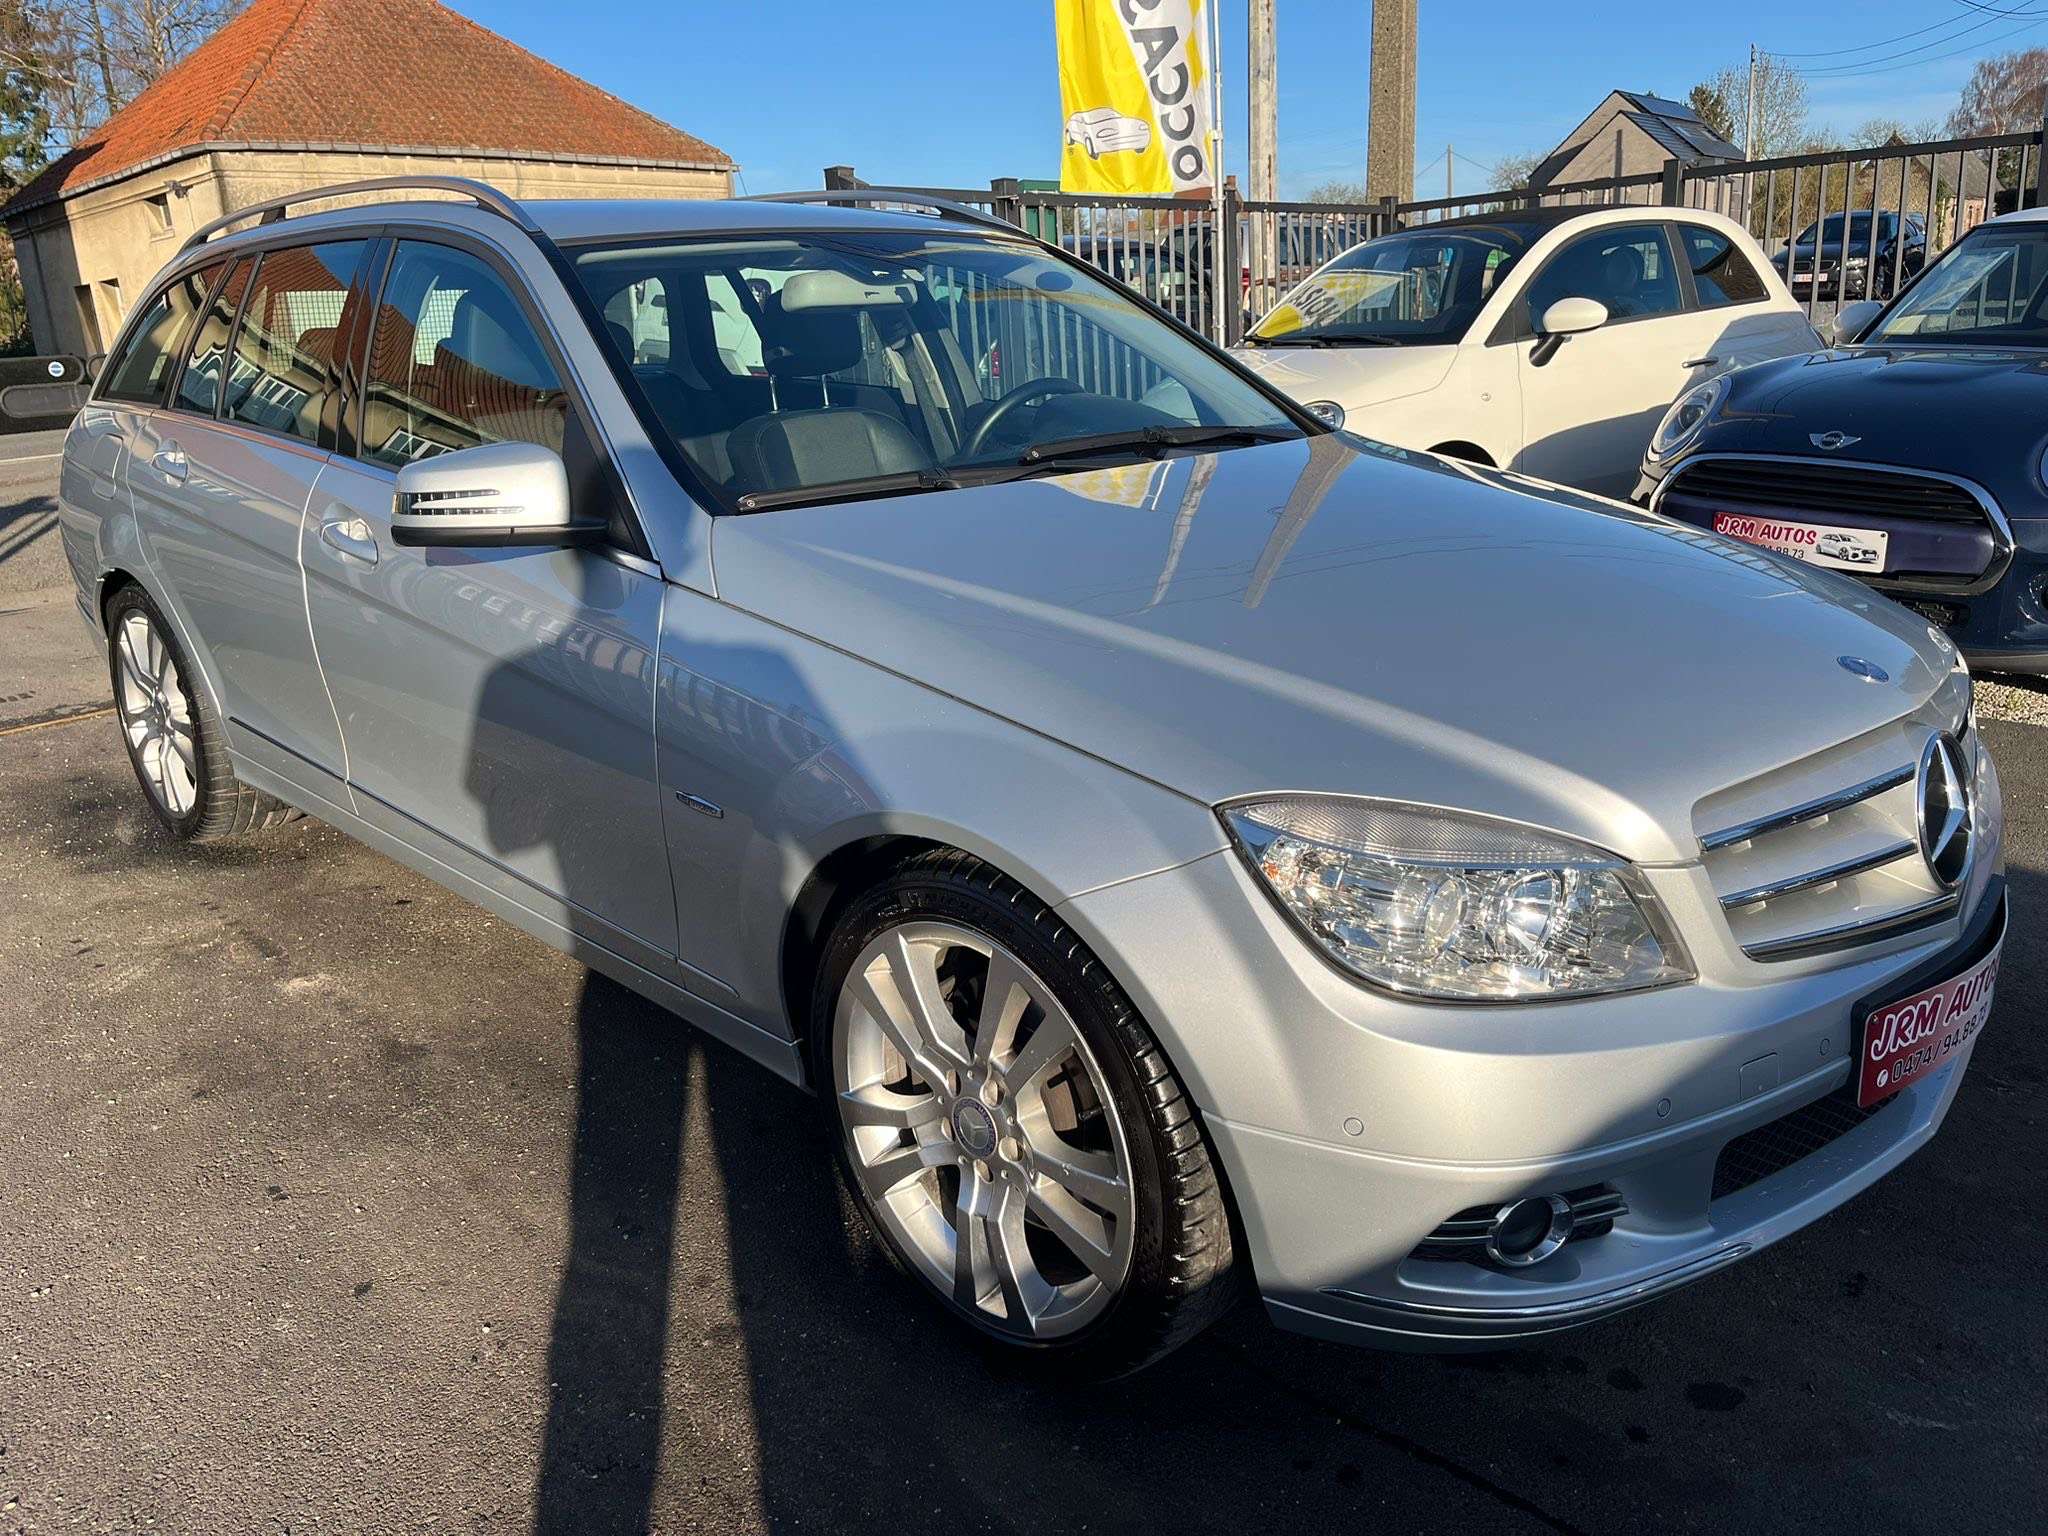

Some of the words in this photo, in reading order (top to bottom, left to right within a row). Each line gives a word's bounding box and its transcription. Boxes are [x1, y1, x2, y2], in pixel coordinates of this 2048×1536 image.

[1717, 516, 1756, 537] JRM
[1759, 521, 1817, 545] AUTOS
[1871, 994, 1943, 1061] JRM
[1892, 1001, 1988, 1082] 0474/94.88
